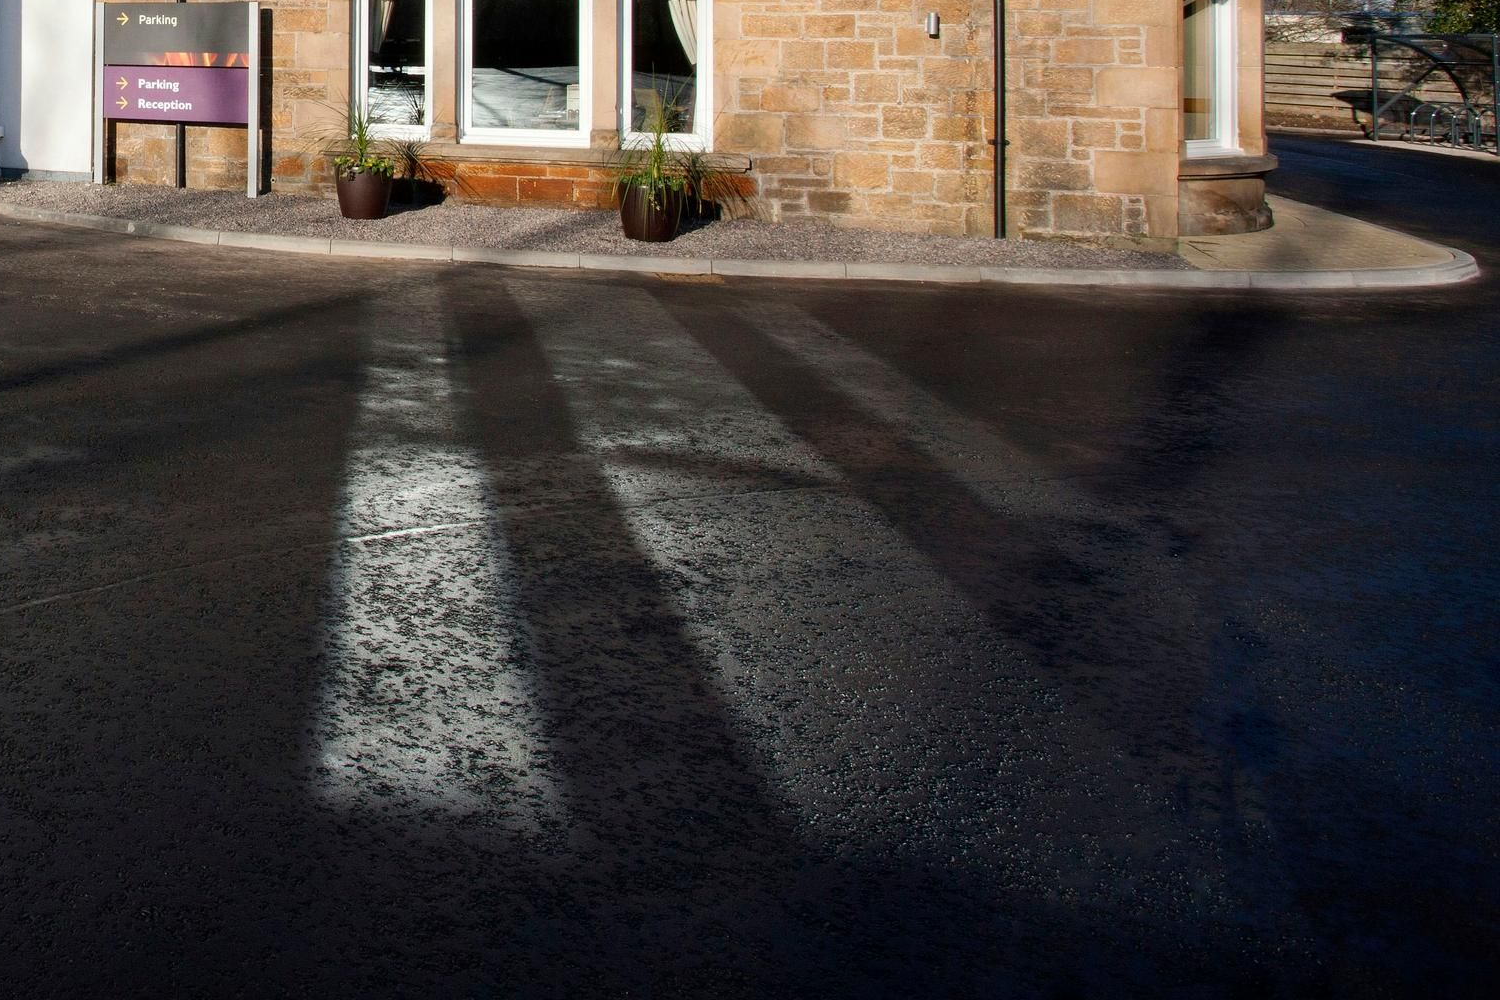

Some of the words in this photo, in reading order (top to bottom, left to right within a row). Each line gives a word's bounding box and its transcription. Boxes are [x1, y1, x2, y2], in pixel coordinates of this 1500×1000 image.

[138, 14, 178, 27] Parking
[137, 78, 180, 92] Parking
[137, 98, 193, 112] Reception
